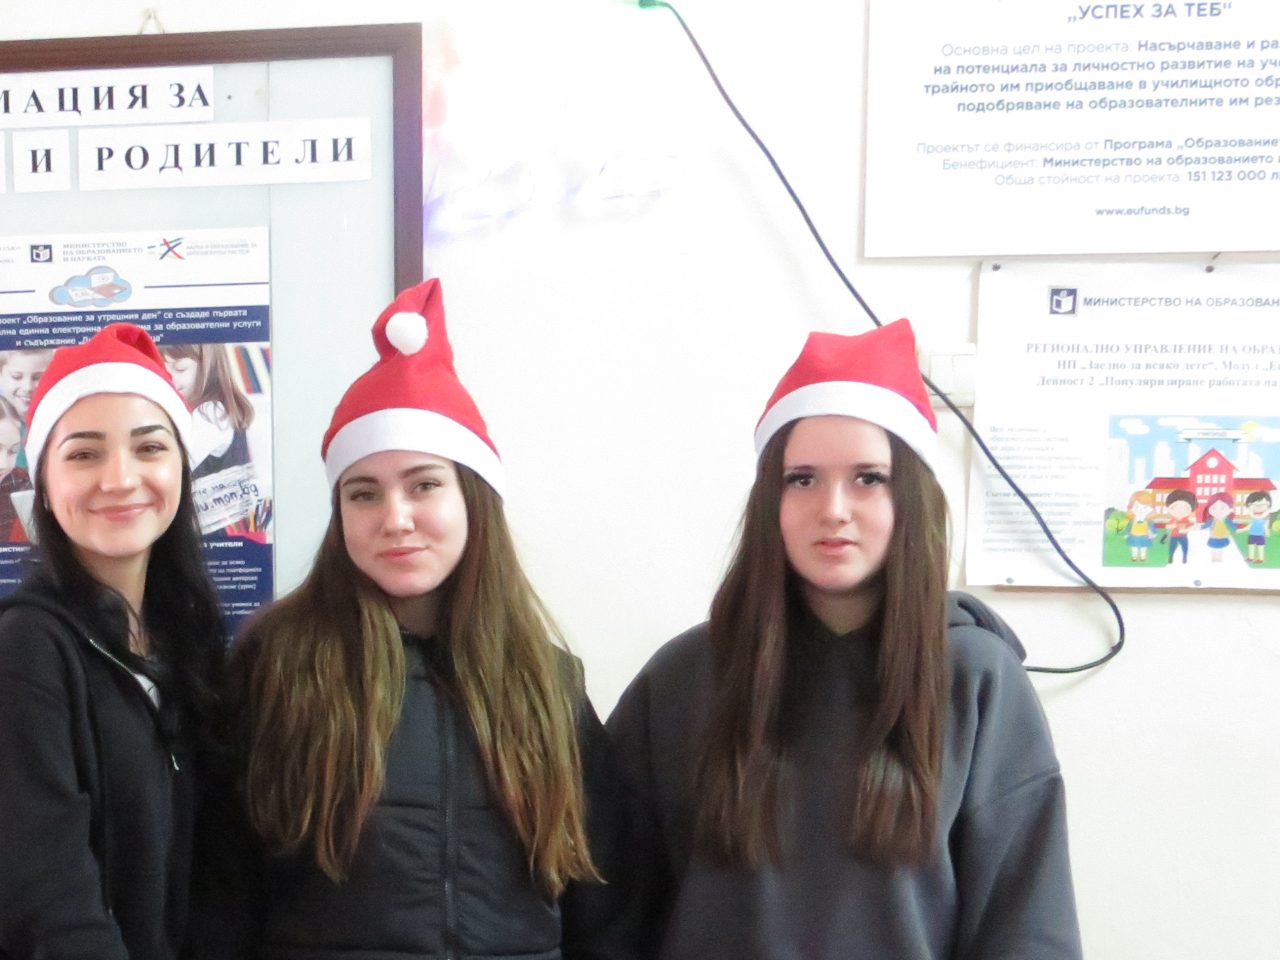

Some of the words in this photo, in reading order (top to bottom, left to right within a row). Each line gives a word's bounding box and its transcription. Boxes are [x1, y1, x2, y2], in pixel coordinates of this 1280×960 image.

[1068, 4, 1144, 23] „УСПЕХ
[1151, 4, 1177, 18] ЗА
[941, 43, 1008, 56] Основна
[1013, 44, 1039, 55] цел
[1045, 44, 1062, 53] на
[1138, 40, 1241, 53] Насърчаване
[1247, 41, 1255, 49] и
[1260, 39, 1280, 51] ра
[934, 65, 951, 75] на
[956, 63, 1046, 75] потенциала
[1051, 63, 1067, 72] за
[1072, 60, 1155, 72] личностно
[1160, 58, 1232, 72] развитие
[1237, 58, 1254, 68] на
[923, 81, 995, 96] трайното
[1000, 82, 1020, 92] им
[1025, 79, 1133, 93] приобщаване
[1138, 80, 1147, 90] в
[1152, 77, 1249, 91] училищното
[168, 81, 210, 109] ЗА
[957, 99, 1061, 113] подобряване
[1066, 100, 1083, 110] на
[1088, 97, 1224, 111] образователните
[1229, 97, 1249, 106] им
[916, 142, 980, 155] Проектът
[984, 143, 999, 152] се
[1003, 140, 1081, 153] финансира
[1085, 142, 1099, 150] от
[1103, 138, 1172, 151] Програма
[29, 147, 53, 174] И
[96, 136, 356, 175] РОДИТЕЛИ
[1043, 157, 1142, 168] Министерство
[1147, 157, 1162, 165] на
[1166, 155, 1273, 167] образованието
[1038, 173, 1100, 185] стойност
[1105, 174, 1120, 183] на
[1188, 171, 1206, 181] 151
[1212, 170, 1232, 181] 123
[1237, 170, 1266, 181] 000
[1095, 205, 1190, 216] www.eufunds.bg
[1083, 297, 1182, 307] МИНИСТЕРСТВО
[1185, 297, 1202, 307] НА
[98, 313, 139, 322] утрешния
[176, 310, 210, 319] създаде
[213, 309, 247, 319] първата
[19, 327, 50, 336] единна
[52, 326, 101, 334] електронна
[153, 323, 163, 331] за
[166, 321, 230, 331] образователни
[232, 320, 261, 330] услуги
[24, 337, 76, 347] съдържание
[1026, 343, 1120, 354] РЕГИОНАЛНО
[1124, 344, 1215, 355] УПРАВЛЕНИЕ
[1220, 345, 1237, 354] НА
[1057, 360, 1077, 370] НП
[1145, 362, 1180, 370] всяко
[1037, 376, 1085, 387] Дейност
[1088, 376, 1095, 386] 2
[1208, 377, 1261, 389] работата
[1264, 379, 1278, 387] на
[210, 541, 243, 549] учители
